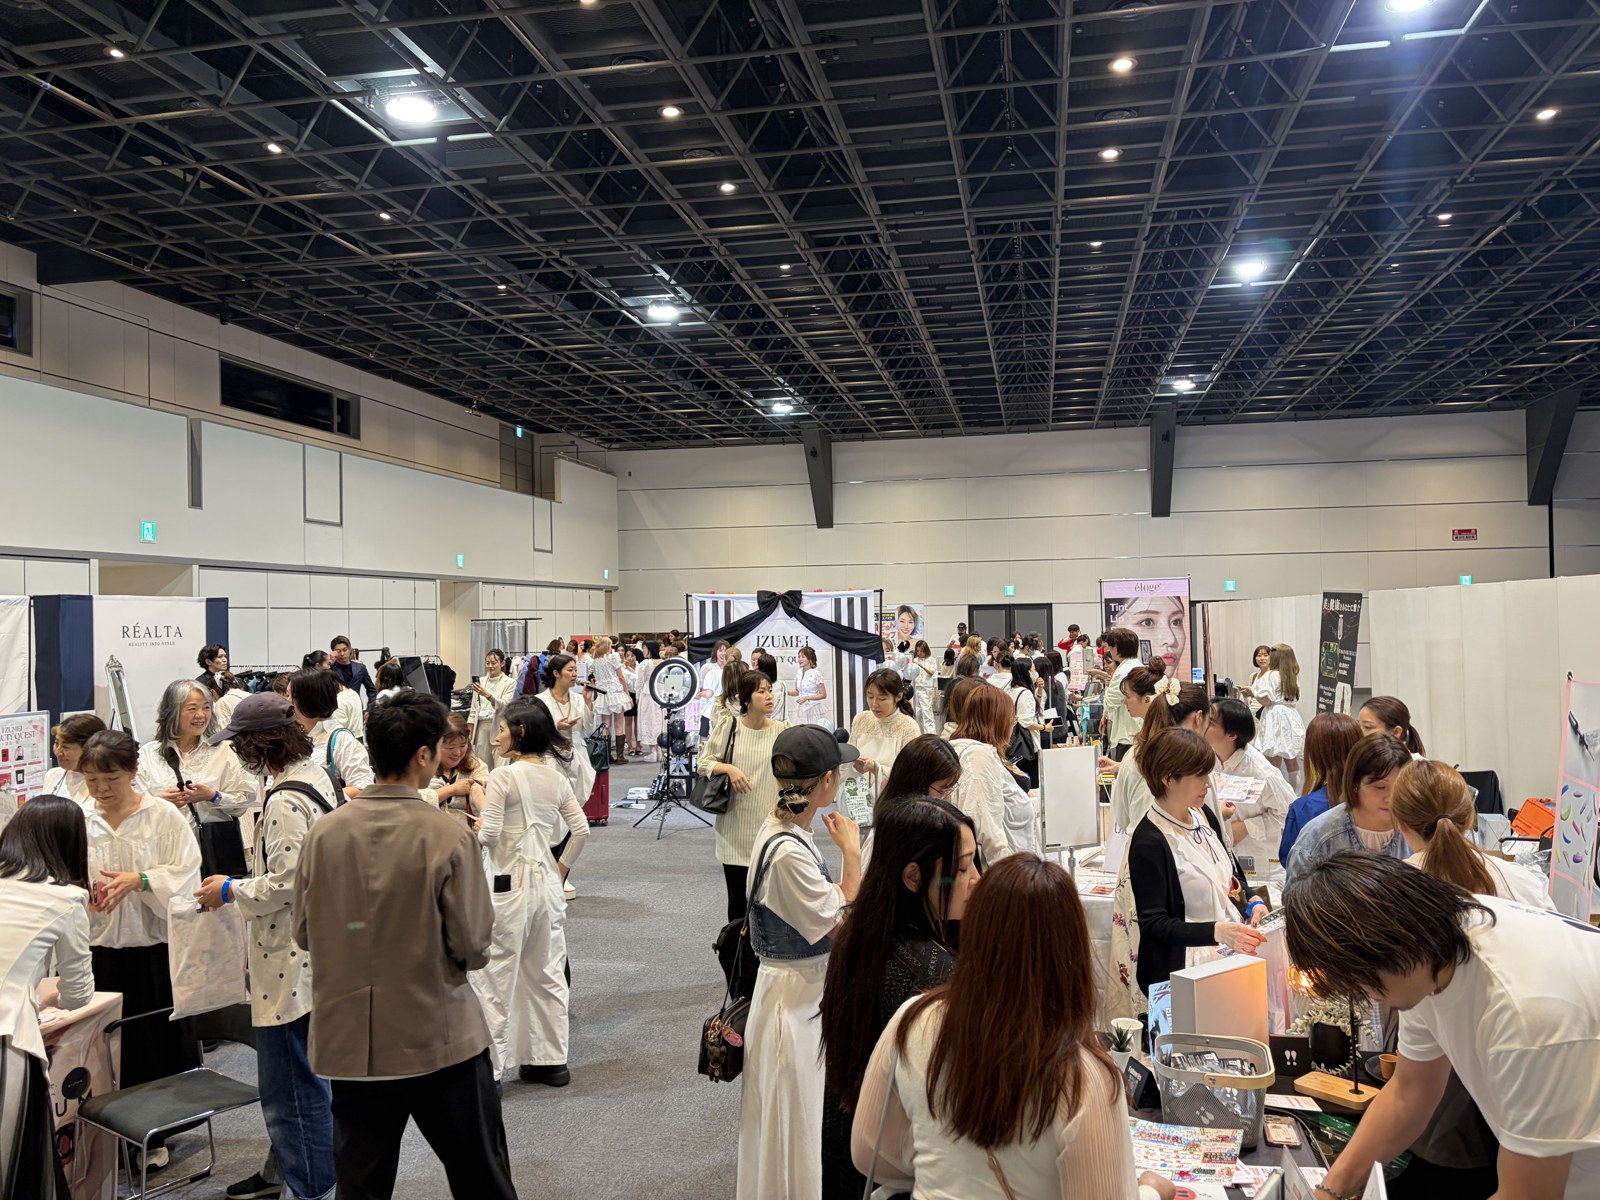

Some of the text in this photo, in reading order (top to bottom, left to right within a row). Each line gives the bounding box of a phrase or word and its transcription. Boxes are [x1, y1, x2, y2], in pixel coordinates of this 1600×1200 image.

[1109, 602, 1128, 611] Tint
[1110, 614, 1125, 624] Lip
[122, 622, 183, 638] RÉALTA
[756, 635, 809, 648] IZUMEI
[14, 730, 36, 741] QUEST
